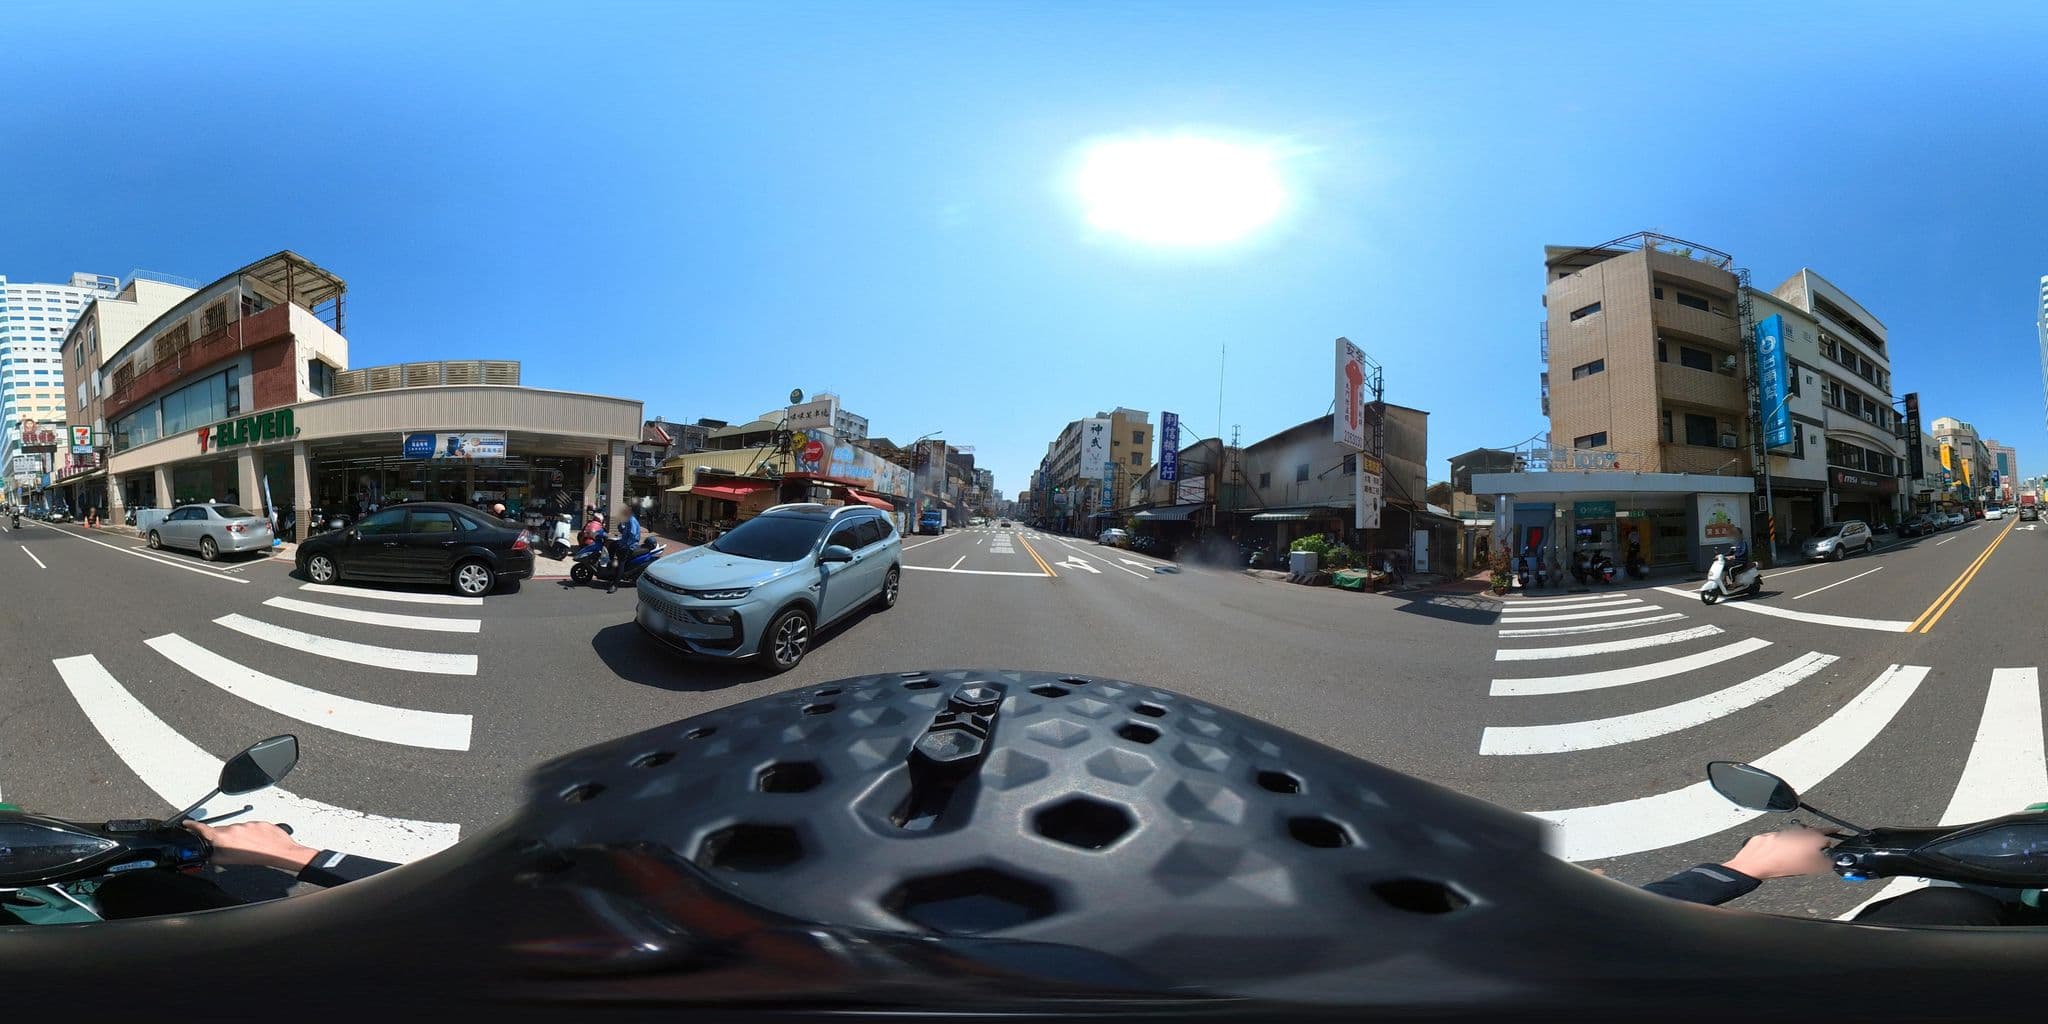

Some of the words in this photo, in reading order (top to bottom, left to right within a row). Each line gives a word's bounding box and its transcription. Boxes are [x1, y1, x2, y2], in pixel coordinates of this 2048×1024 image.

[198, 409, 296, 453] 7-ELEVEN
[1162, 413, 1177, 480] 利信機車行
